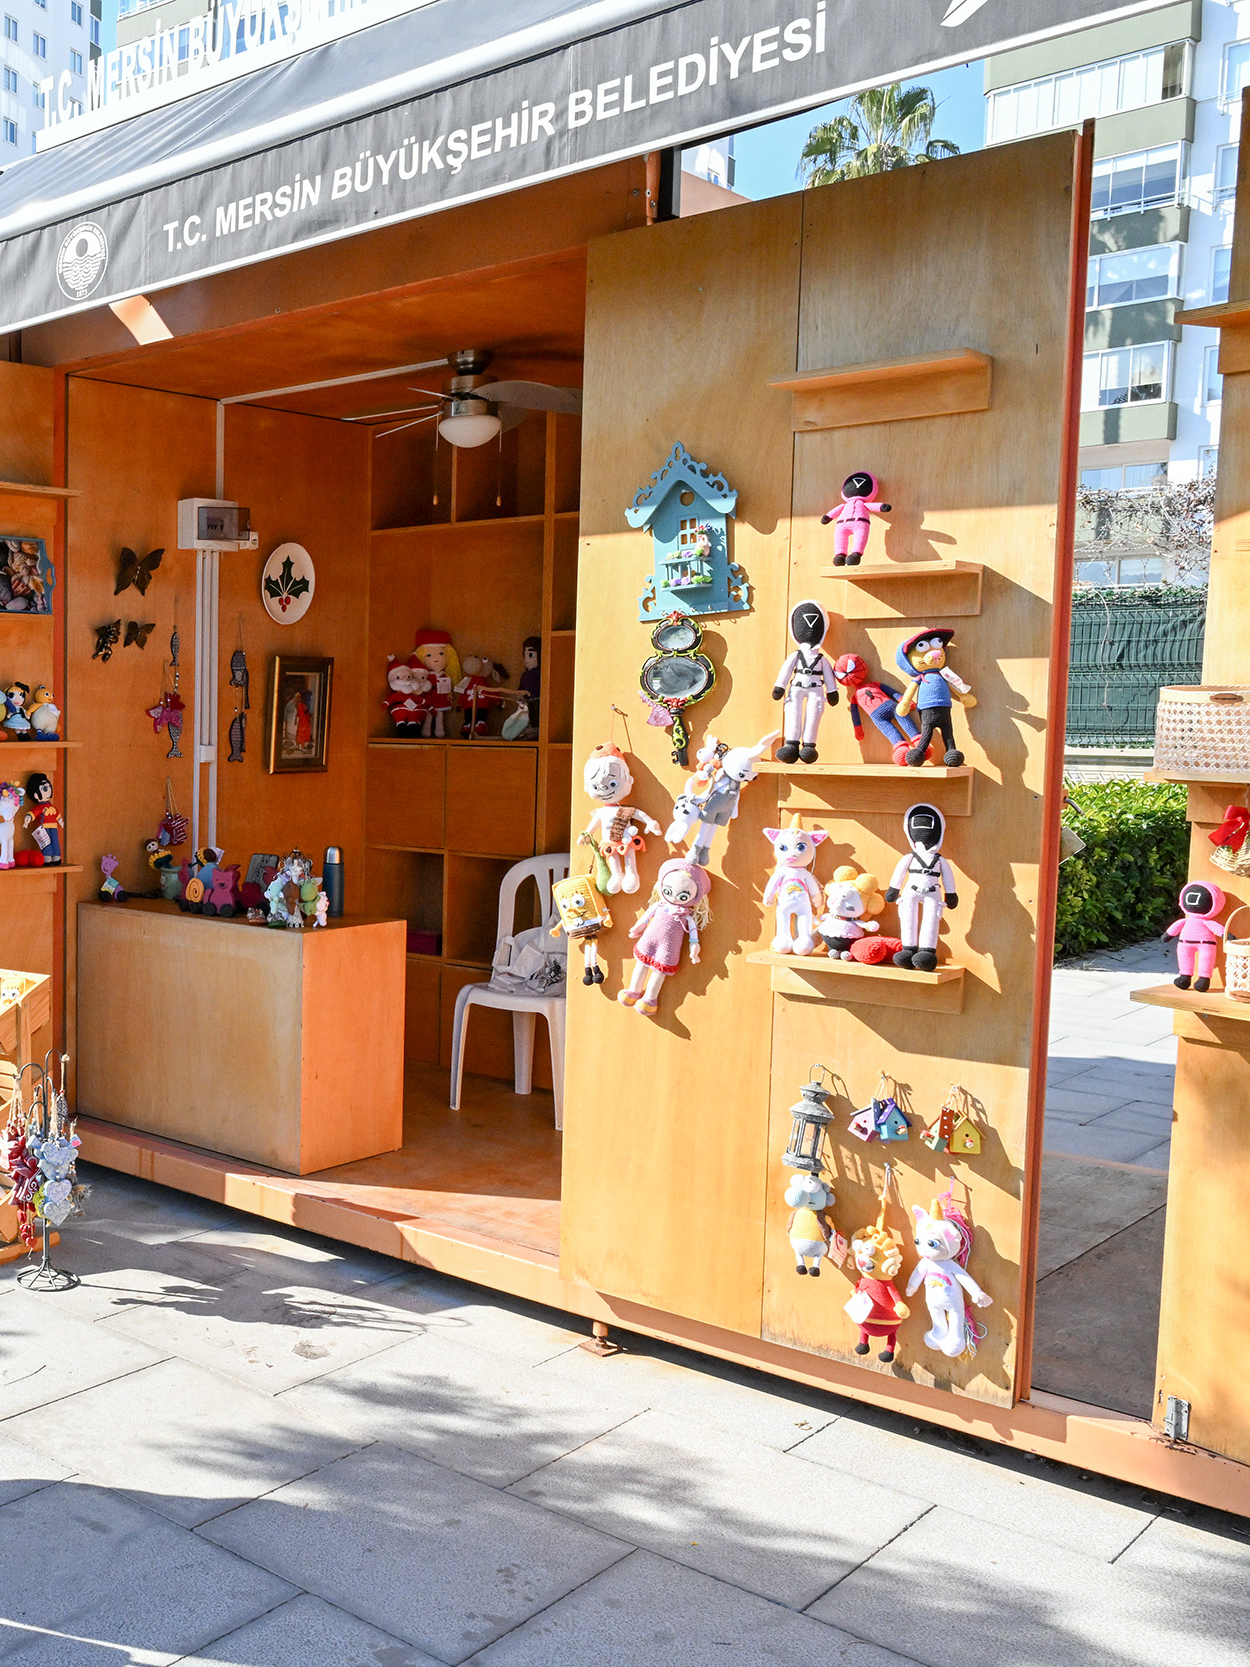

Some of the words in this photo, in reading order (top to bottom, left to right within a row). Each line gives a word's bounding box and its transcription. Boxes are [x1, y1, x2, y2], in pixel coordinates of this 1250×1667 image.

[40, 71, 83, 129] T.C.
[86, 18, 181, 113] MERSİN
[163, 215, 207, 252] T.C.
[215, 173, 321, 237] MERSİN
[331, 100, 556, 201] BÜYÜKŞEHİR
[568, 1, 826, 129] BELEDİYESİ
